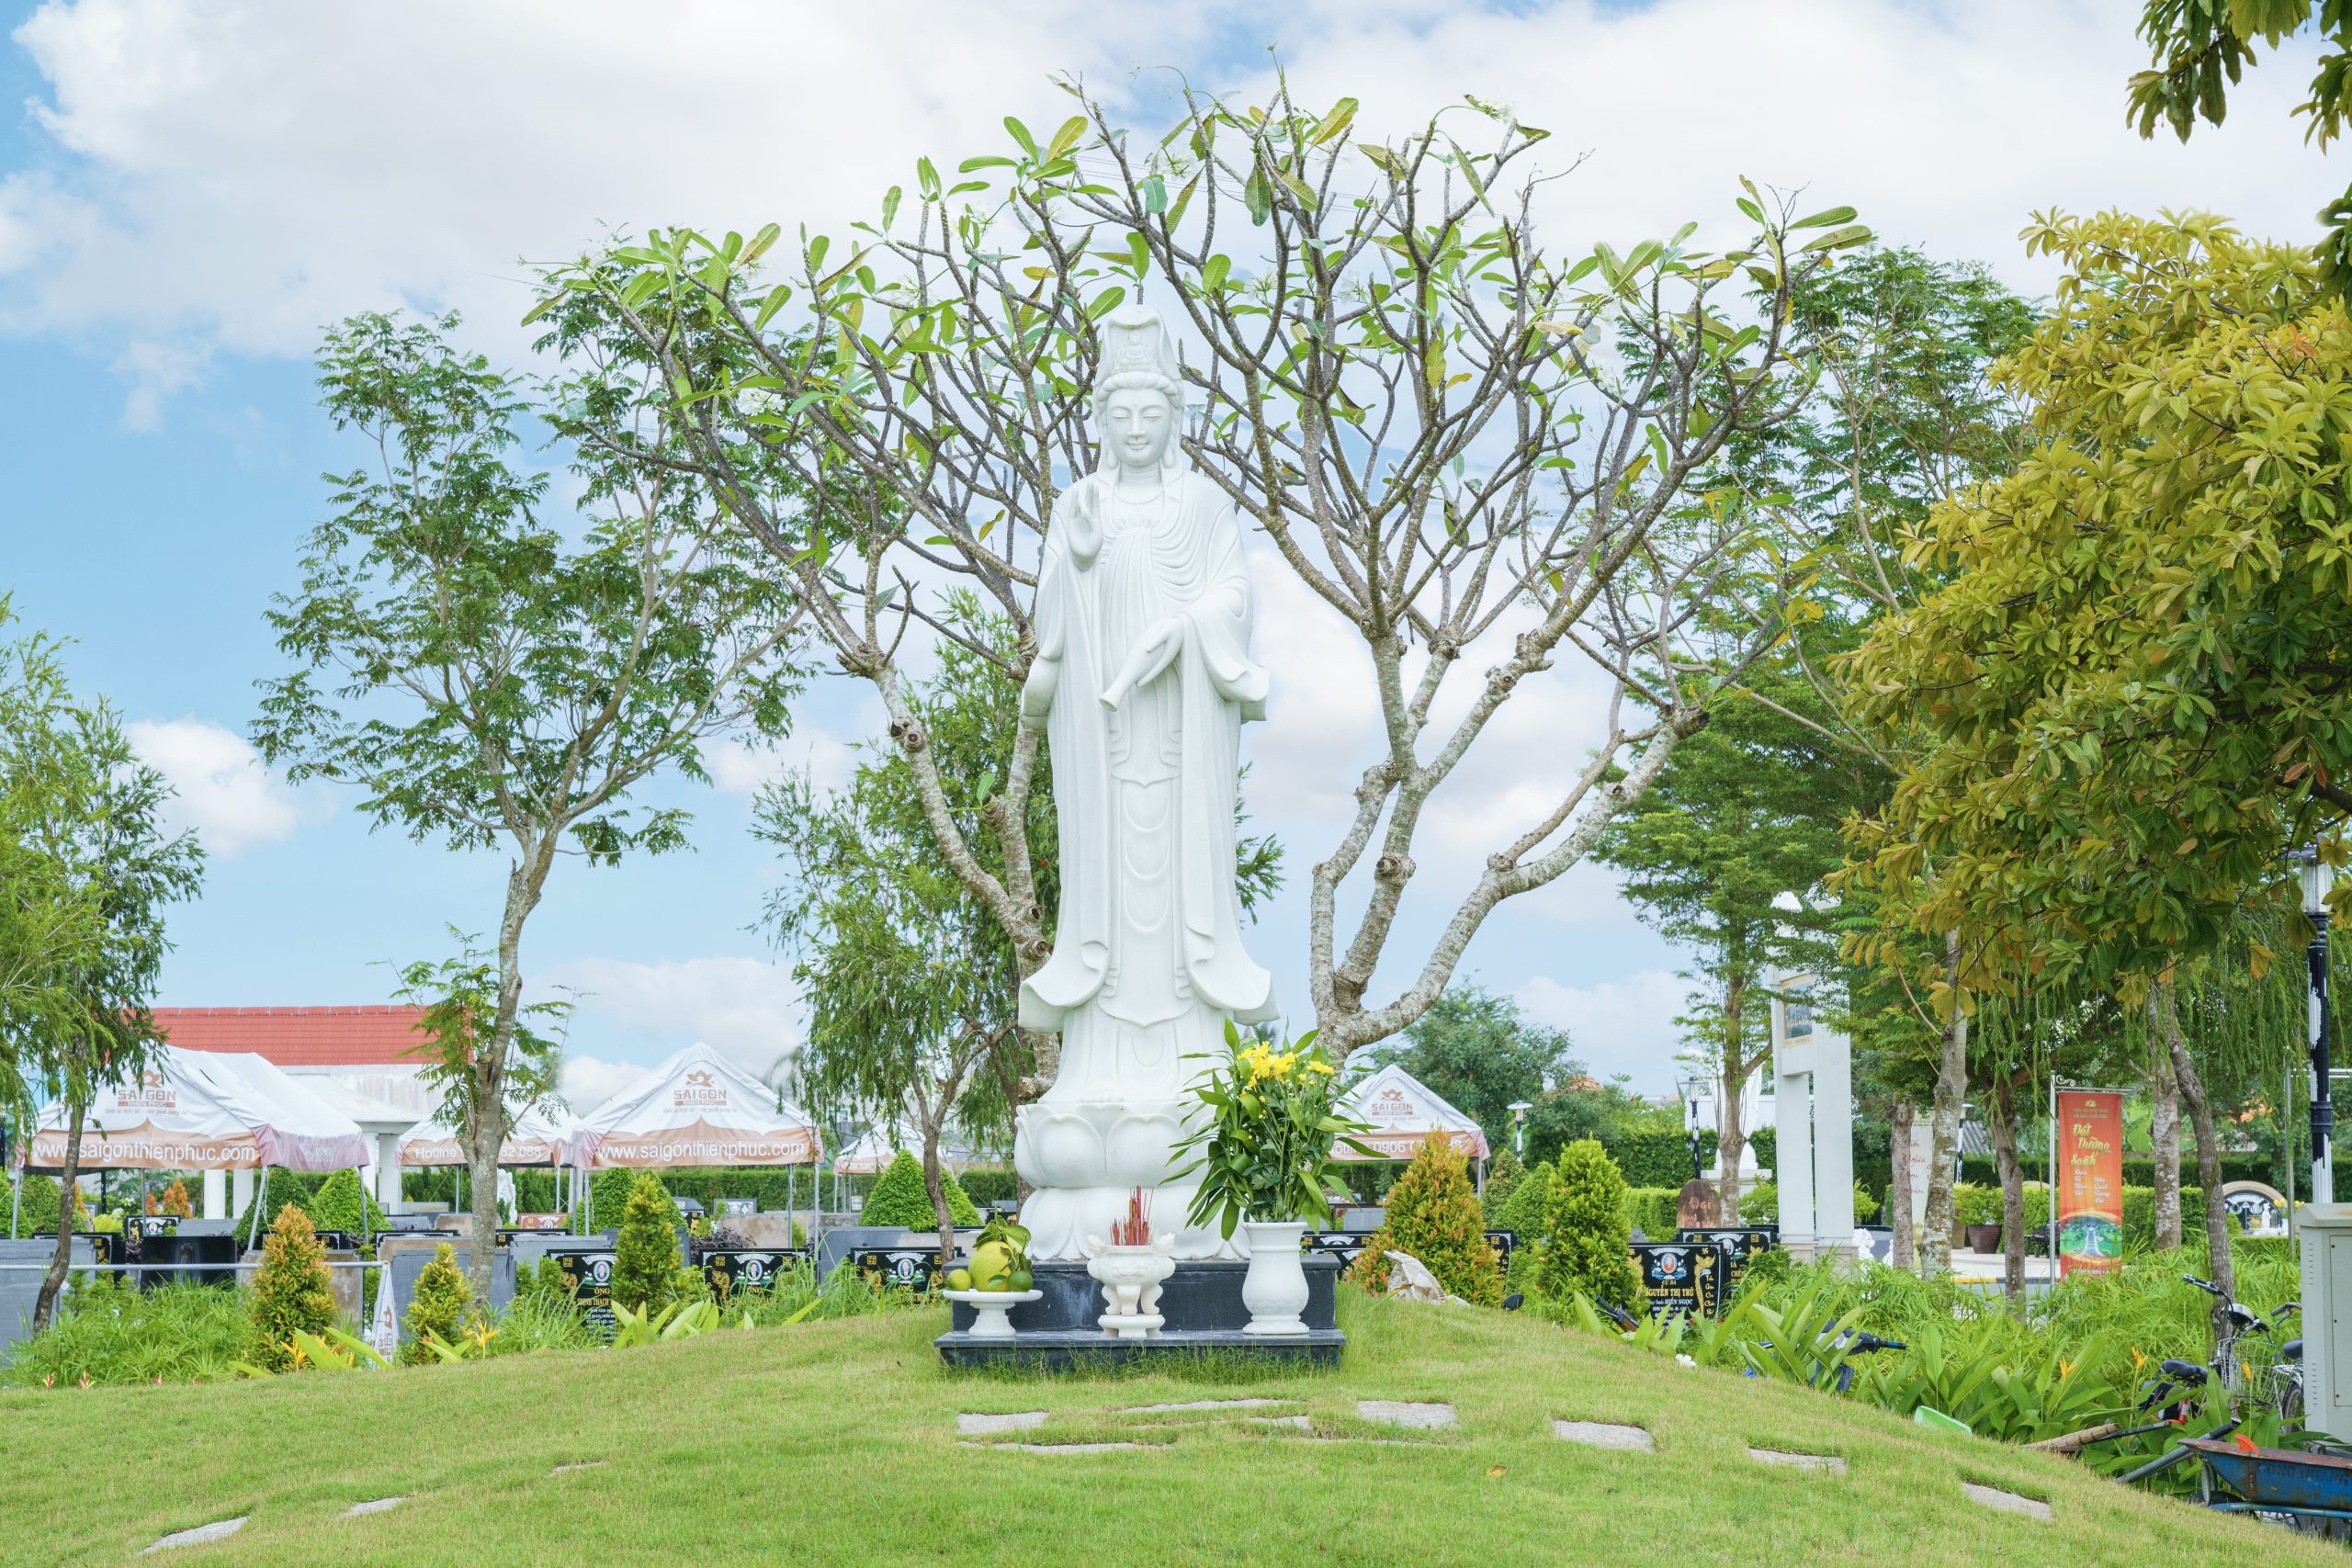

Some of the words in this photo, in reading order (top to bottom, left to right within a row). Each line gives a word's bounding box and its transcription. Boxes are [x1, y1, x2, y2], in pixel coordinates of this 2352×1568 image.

[32, 1141, 256, 1164] wwwsaigonthienphuc.com
[415, 1145, 457, 1160] Hotline
[519, 1145, 541, 1156] 088
[597, 1141, 805, 1161] www.saigonthienphuc.com
[1374, 1141, 1406, 1153] 0906
